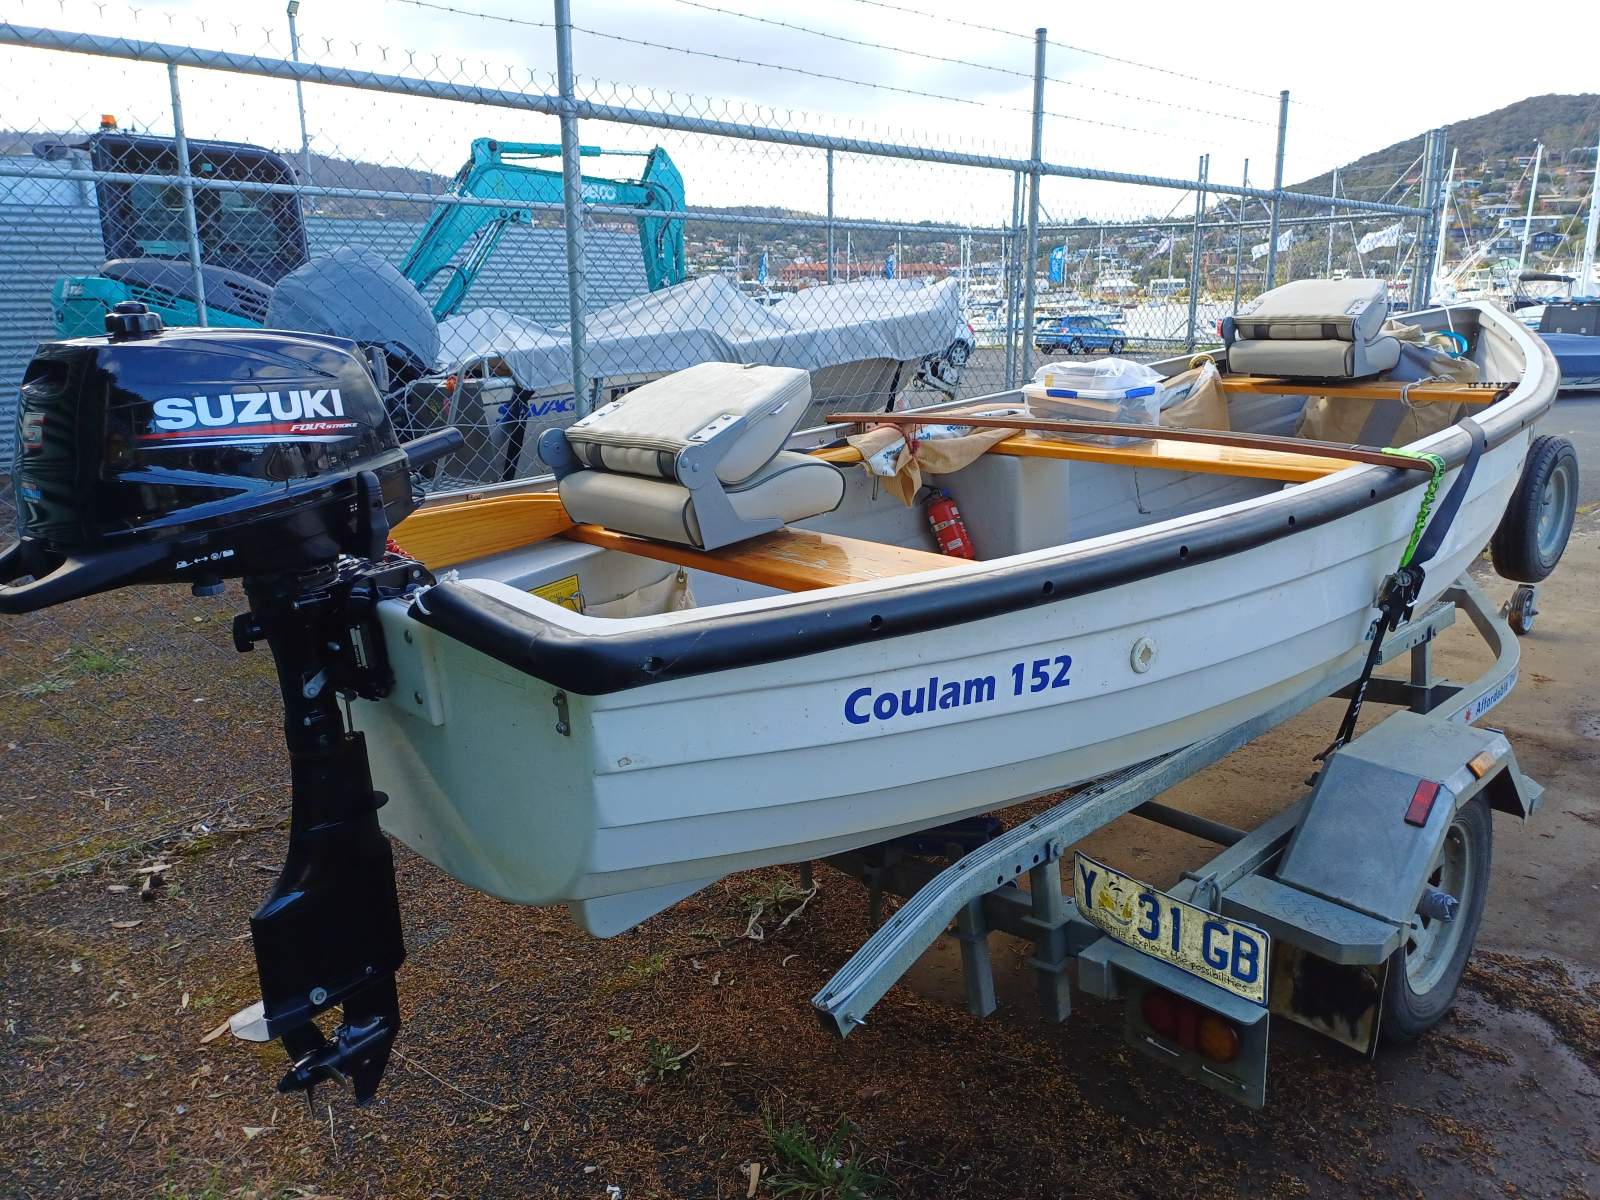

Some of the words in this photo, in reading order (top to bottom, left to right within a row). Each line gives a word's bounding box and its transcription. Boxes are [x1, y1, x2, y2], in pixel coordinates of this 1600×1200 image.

[153, 388, 345, 430] SUZUKI
[844, 674, 996, 725] Coulam
[1011, 655, 1073, 696] 152
[1079, 863, 1098, 910] Y
[1137, 893, 1182, 953] 31
[1201, 920, 1260, 984] GB
[1131, 934, 1169, 956] Explore
[1190, 961, 1248, 993] possibilities
